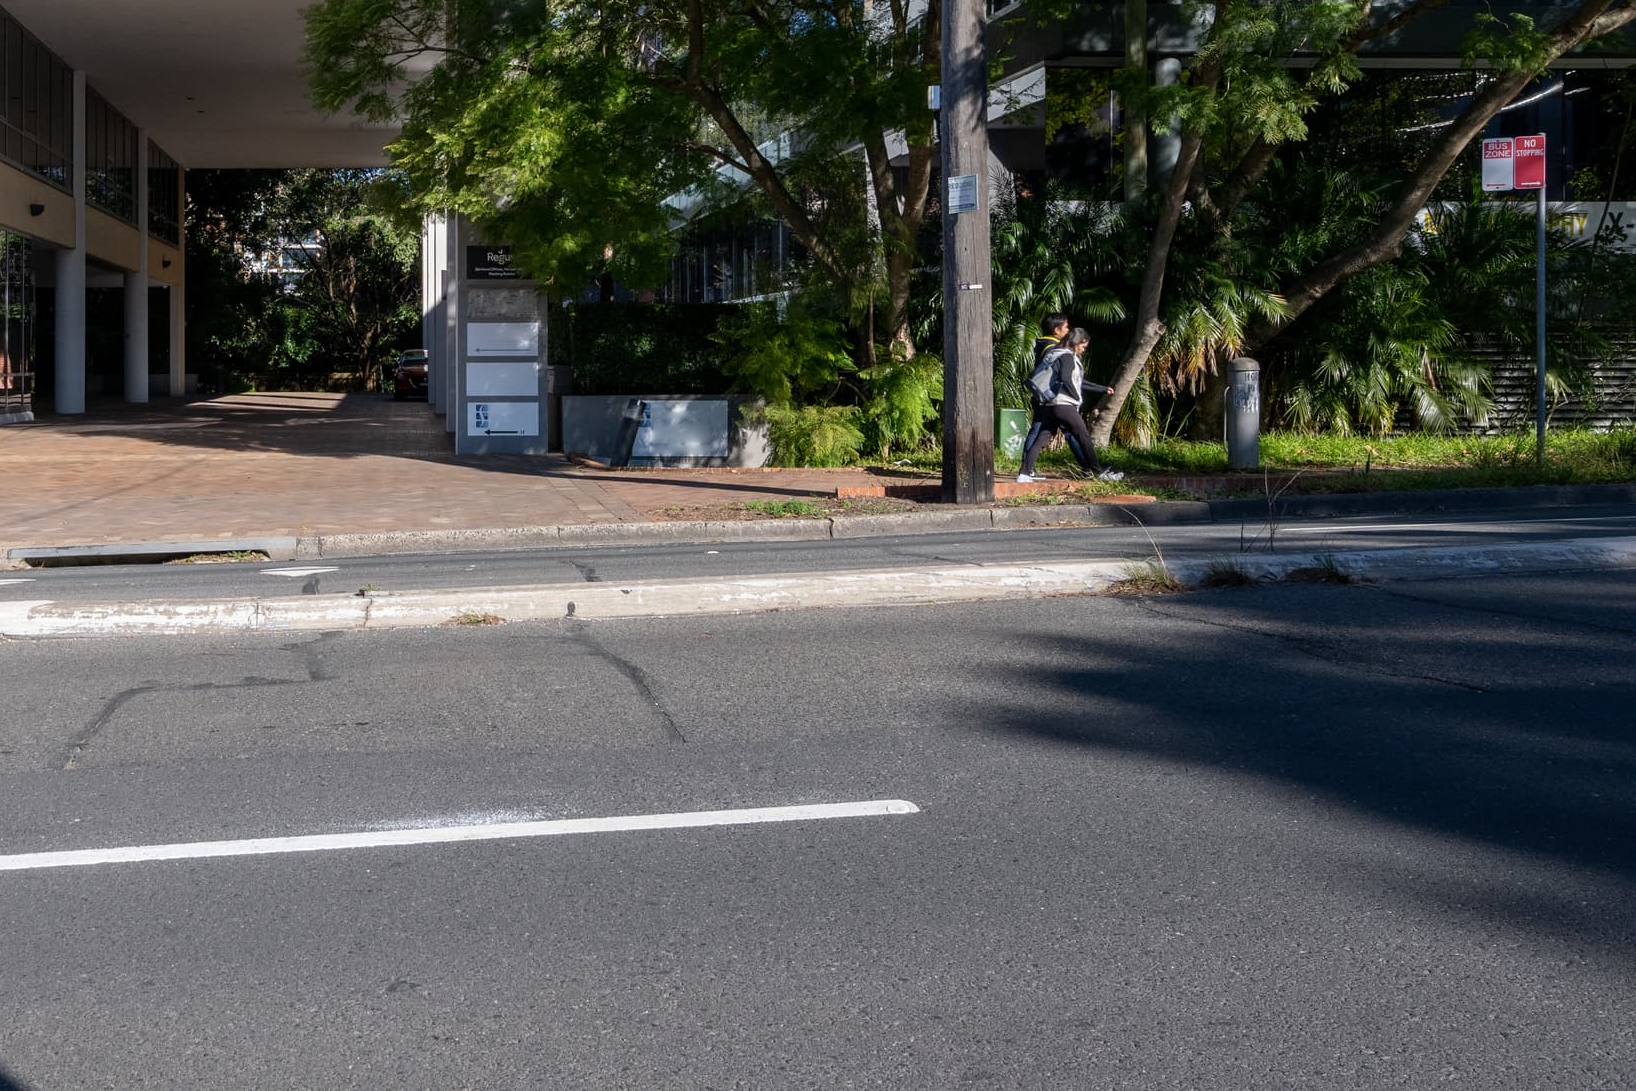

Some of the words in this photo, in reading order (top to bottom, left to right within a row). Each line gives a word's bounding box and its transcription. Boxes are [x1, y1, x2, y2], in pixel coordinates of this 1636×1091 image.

[1488, 142, 1508, 151] BUS
[1524, 139, 1537, 148] NO
[1485, 150, 1511, 158] ZONE
[1515, 149, 1544, 157] STOPPING
[487, 252, 512, 265] Regu
